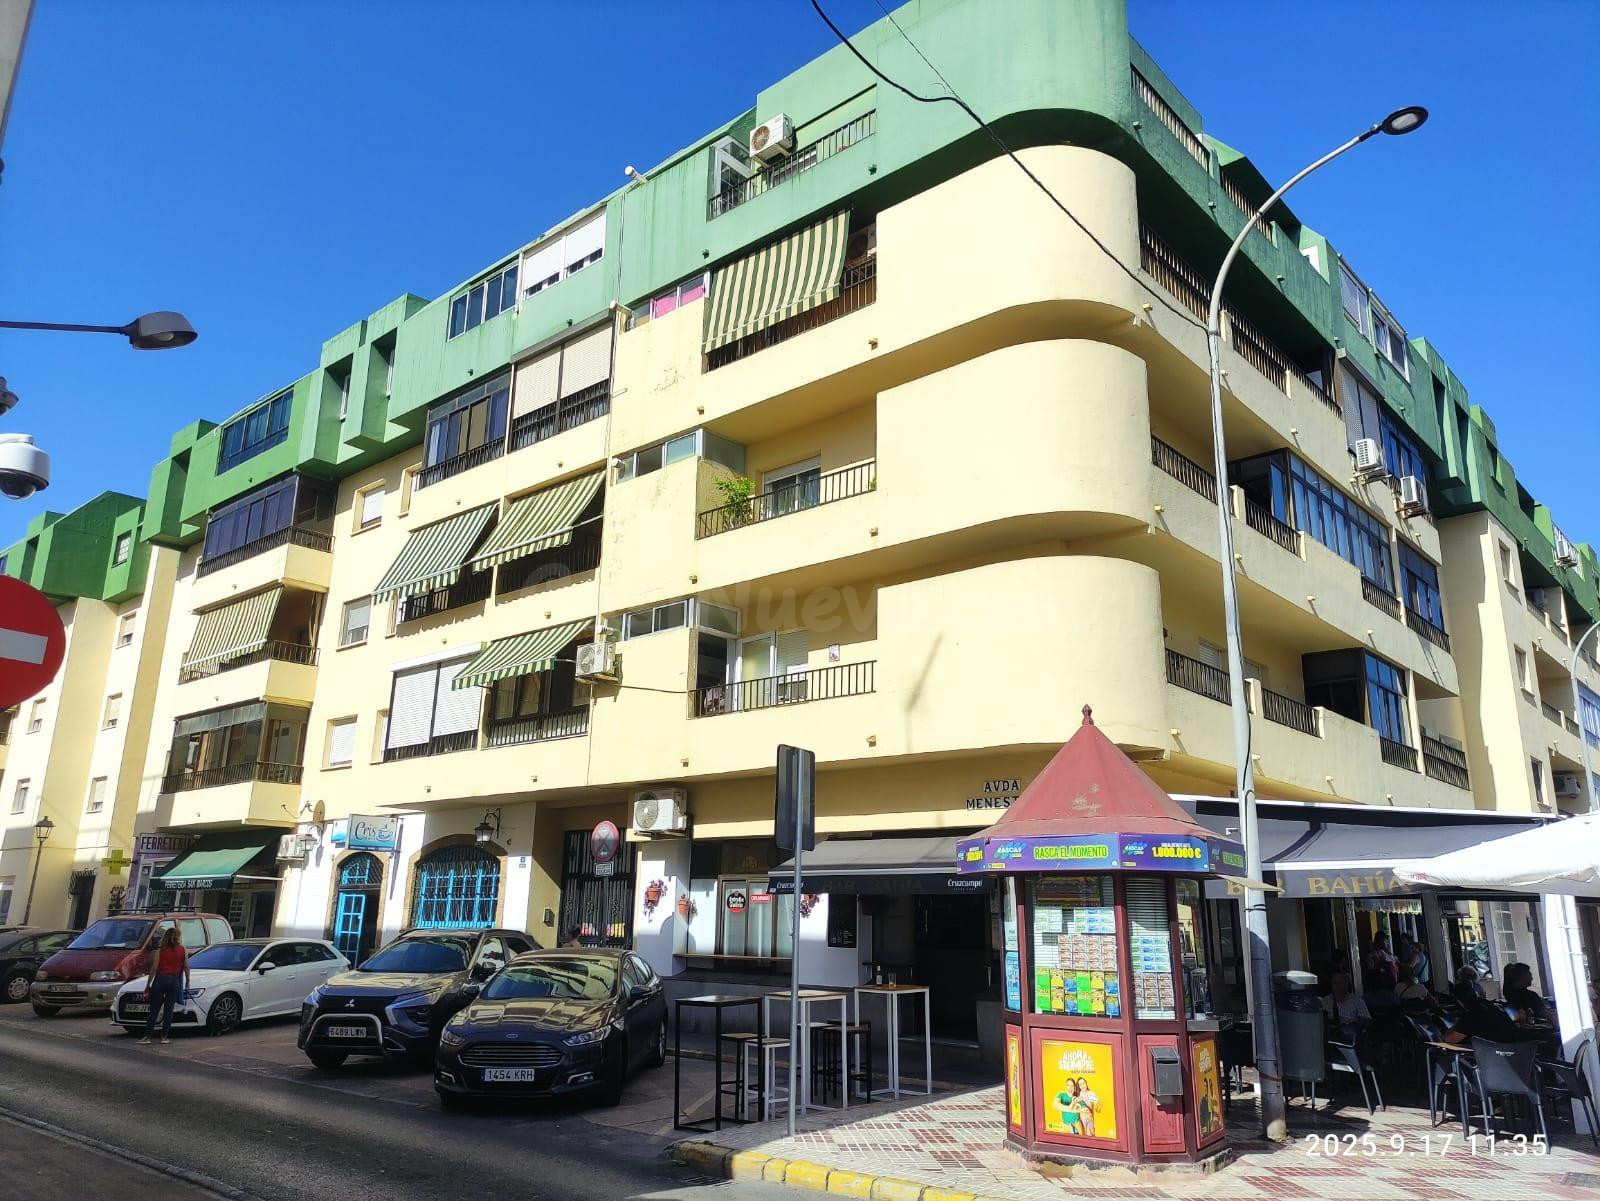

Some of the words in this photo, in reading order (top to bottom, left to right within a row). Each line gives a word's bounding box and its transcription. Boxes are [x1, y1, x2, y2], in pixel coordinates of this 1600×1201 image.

[984, 780, 1019, 792] AVDA
[1034, 847, 1059, 858] RASCA
[1060, 847, 1069, 857] EL
[1069, 846, 1108, 857] MOMENTO
[947, 878, 983, 888] Cruzcampo
[488, 1070, 511, 1080] 1454
[514, 1070, 533, 1080] KRH
